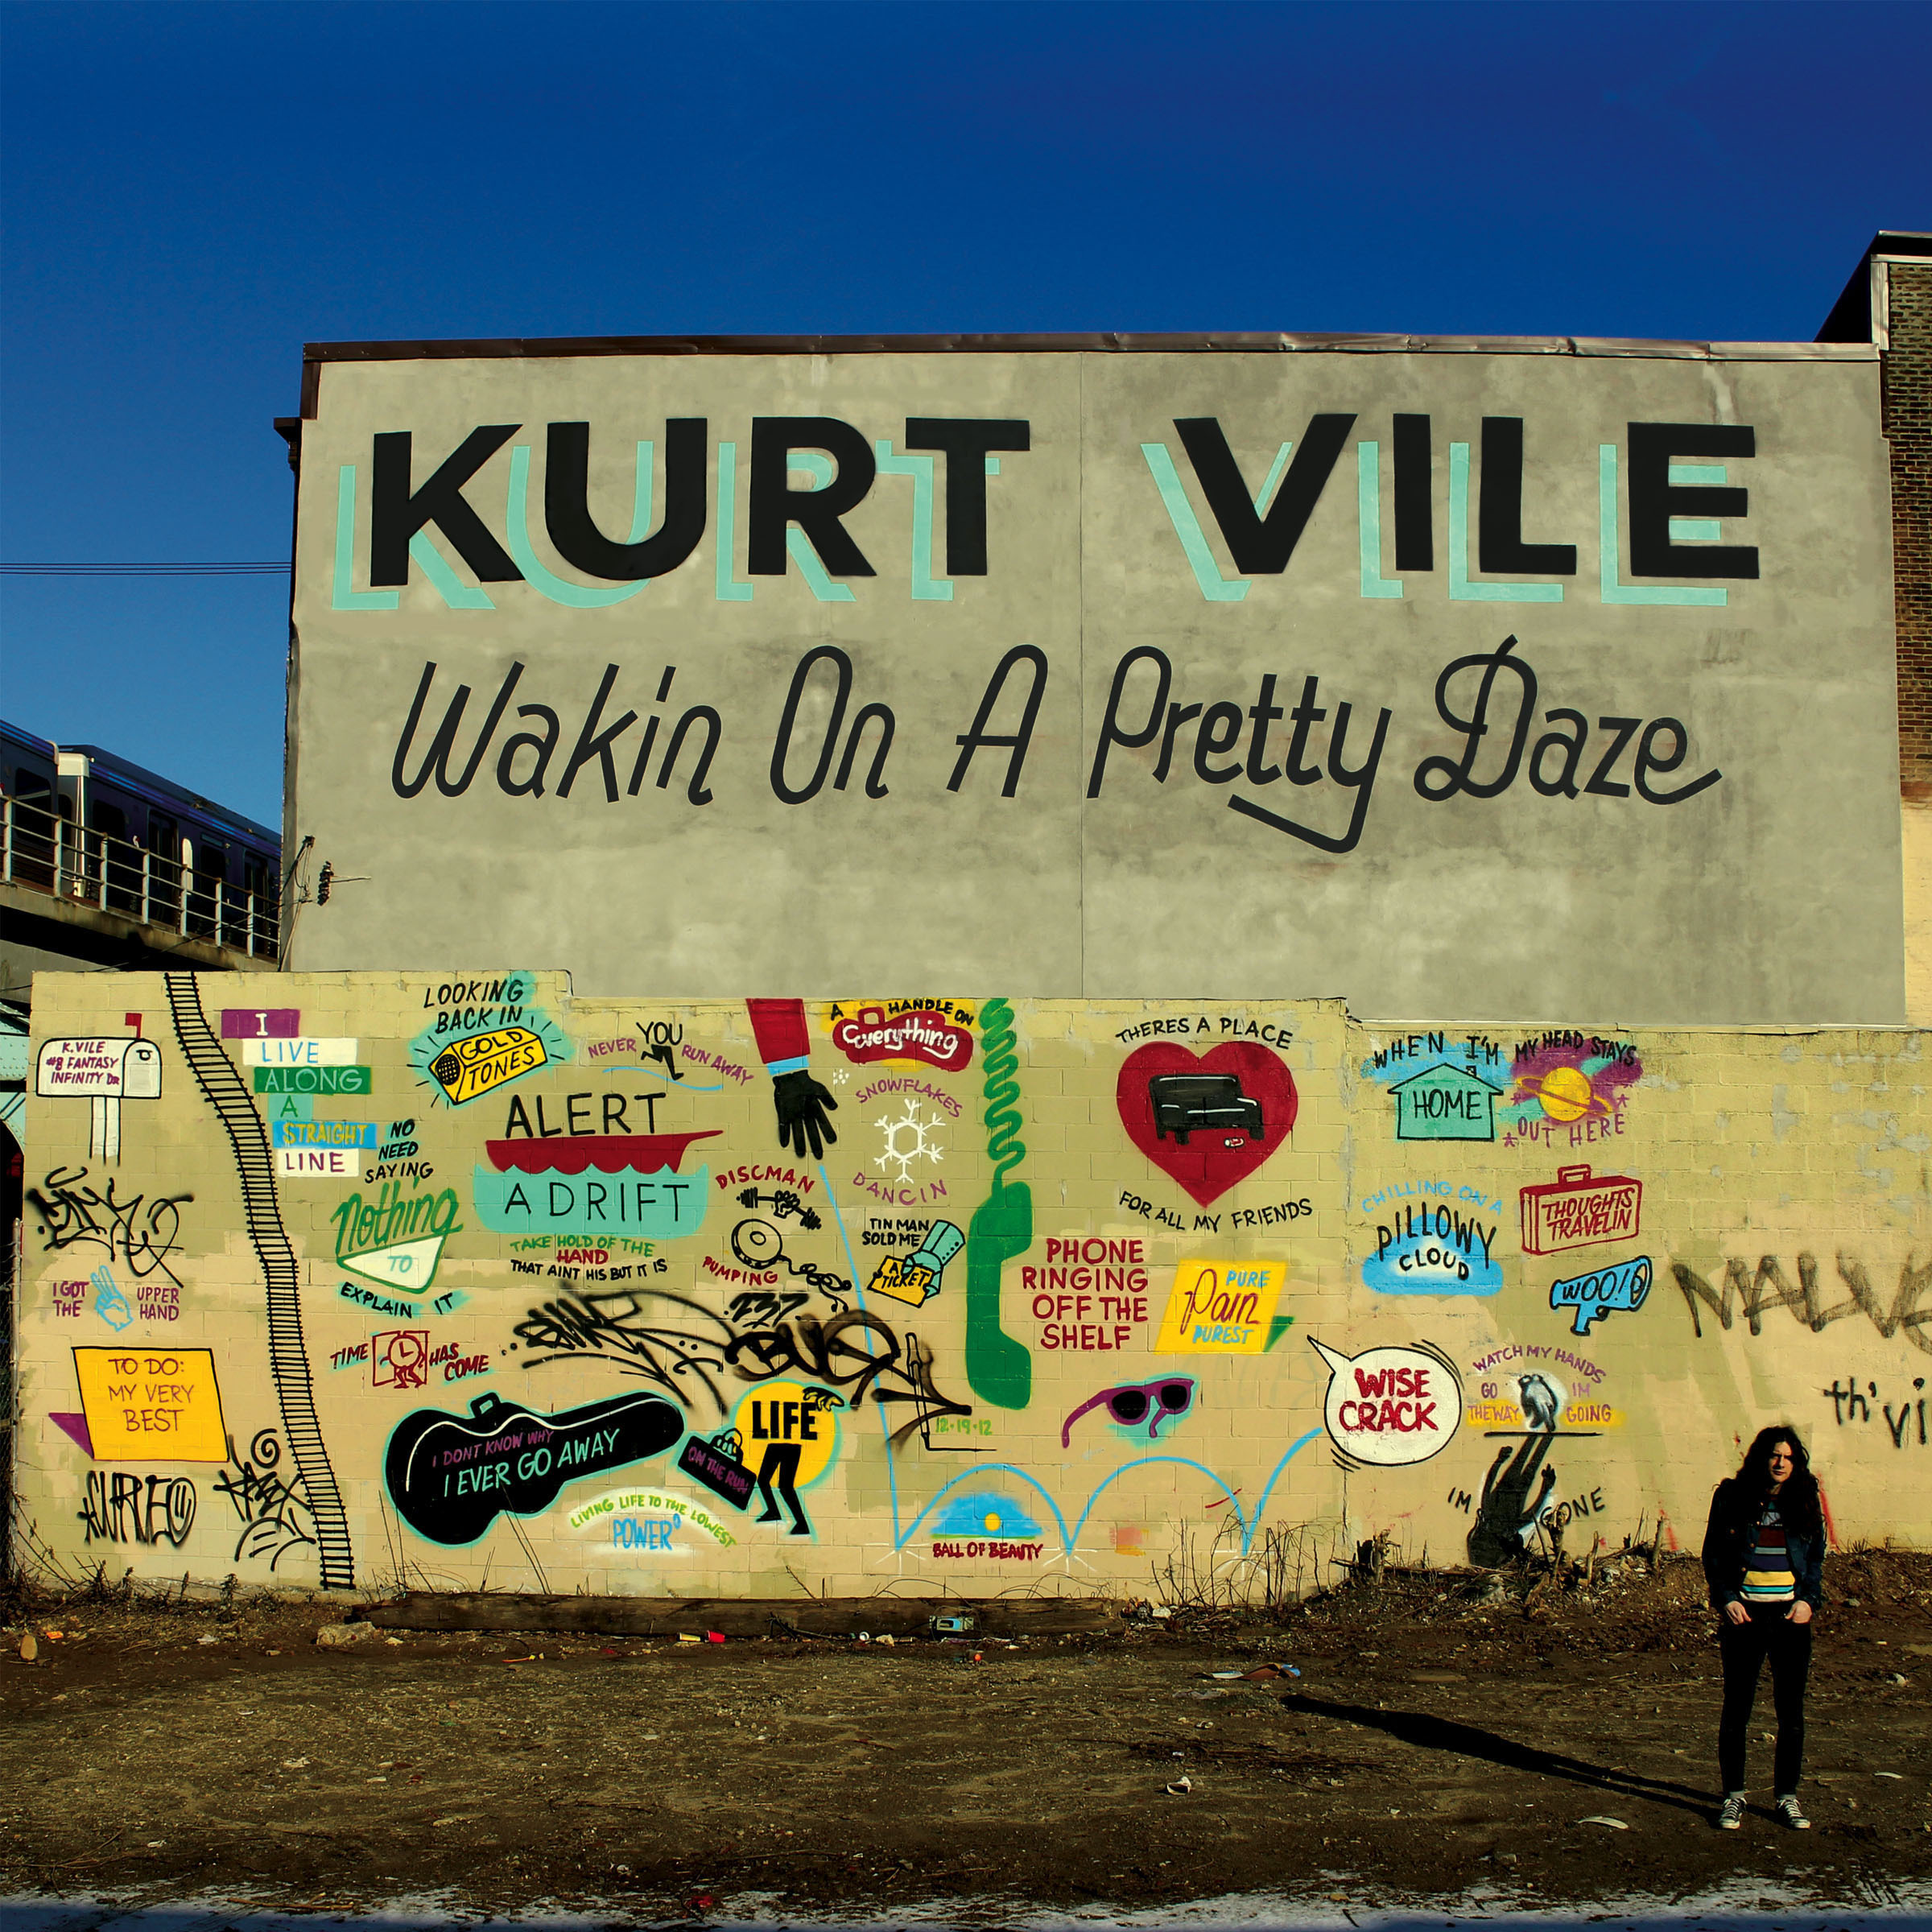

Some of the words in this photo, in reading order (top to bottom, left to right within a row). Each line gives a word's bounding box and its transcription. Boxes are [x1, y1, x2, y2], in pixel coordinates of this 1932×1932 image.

[370, 416, 1030, 587] KURT
[1173, 413, 1760, 579] VILE
[391, 659, 721, 806] Wakin
[770, 645, 895, 805] On
[946, 644, 1049, 799] A
[1086, 645, 1392, 854] Pretty
[1414, 634, 1723, 805] Daze
[423, 980, 524, 1008] LOOKING
[256, 1013, 269, 1036] I
[435, 1009, 489, 1034] BACK
[498, 1007, 522, 1024] IN
[831, 1004, 844, 1021] A
[889, 999, 953, 1014] HANDLE
[955, 1009, 974, 1026] ON
[460, 1027, 522, 1060] GOLD
[843, 1018, 959, 1059] Everything
[1115, 1018, 1190, 1043] THERES
[1196, 1017, 1210, 1033] A
[1220, 1018, 1293, 1050] PLACE
[262, 1042, 319, 1063] LIVE
[588, 1038, 637, 1059] NEVER
[636, 1022, 683, 1045] YOU
[681, 1044, 711, 1065] RUN
[711, 1058, 753, 1086] AWAY
[1374, 1030, 1444, 1069] WHEN
[1515, 1038, 1539, 1063] MY
[1542, 1030, 1584, 1051] HEAD
[1591, 1037, 1637, 1066] STAYS
[67, 1057, 118, 1069] FANTASY
[469, 1046, 535, 1091] TONES
[51, 1071, 104, 1084] INFINITY
[264, 1069, 362, 1092] ALONG
[280, 1095, 298, 1117] A
[856, 1079, 963, 1118] SNOWFLAKES
[1412, 1089, 1482, 1120] HOME
[506, 1092, 667, 1138] ALERT
[283, 1123, 368, 1145] STRAIGHT
[390, 1119, 415, 1138] NO
[1518, 1117, 1555, 1148] OUT
[1570, 1113, 1625, 1147] HERE
[286, 1152, 345, 1172] LINE
[378, 1141, 419, 1161] NEED
[365, 1162, 434, 1183] SAYING
[716, 1165, 815, 1193] DISCMAN
[852, 1172, 947, 1206] DANCIN
[1361, 1180, 1452, 1213] CHILLING
[1459, 1186, 1488, 1206] ON
[1488, 1200, 1503, 1215] A
[1120, 1191, 1152, 1219] FOR
[1155, 1208, 1186, 1230] ALL
[1194, 1214, 1221, 1232] MY
[1231, 1198, 1312, 1229] FRIENDS
[1542, 1188, 1636, 1221] THOUGHTS
[870, 1218, 892, 1229] TIN
[897, 1220, 929, 1232] MAN
[1377, 1201, 1496, 1269] PILLOWY
[1547, 1209, 1632, 1241] TRAVELIN
[510, 1236, 552, 1252] TAKE
[557, 1235, 593, 1247] HOLD
[597, 1237, 616, 1249] OF
[621, 1239, 655, 1257] THE
[862, 1231, 897, 1245] SOLD
[899, 1233, 921, 1247] ME
[1046, 1238, 1144, 1264] PHONE
[387, 1256, 413, 1272] TO
[510, 1259, 543, 1275] THAT
[547, 1265, 580, 1280] AINT
[586, 1269, 607, 1281] HIS
[610, 1265, 632, 1281] BUT
[638, 1265, 646, 1277] IT
[653, 1258, 667, 1274] IS
[556, 1249, 609, 1265] HAND
[889, 1262, 898, 1275] A
[1399, 1249, 1469, 1281] CLOUD
[702, 1256, 778, 1286] PUMPING
[882, 1270, 930, 1289] TICKET
[1022, 1267, 1148, 1293] RINGING
[1225, 1270, 1271, 1288] PURE
[52, 1282, 57, 1297] I
[60, 1282, 90, 1297] GOT
[137, 1287, 180, 1304] UPPER
[341, 1282, 412, 1319] EXPLAIN
[435, 1293, 453, 1315] IT
[52, 1300, 84, 1317] THE
[139, 1304, 180, 1321] HAND
[1032, 1294, 1092, 1321] OFF
[1099, 1296, 1148, 1322] THE
[1041, 1323, 1131, 1350] SHELF
[1192, 1326, 1254, 1344] PUREST
[108, 1358, 138, 1375] TO
[145, 1358, 184, 1375] DO:
[330, 1343, 369, 1369] TIME
[429, 1342, 459, 1366] HAS
[1472, 1345, 1523, 1372] WATCH
[1526, 1345, 1552, 1358] MY
[1554, 1348, 1607, 1384] HANDS
[444, 1355, 489, 1381] COME
[108, 1385, 138, 1402] MY
[145, 1385, 194, 1404] VERY
[1355, 1368, 1431, 1399] WISE
[1481, 1382, 1498, 1398] GO
[1571, 1382, 1591, 1397] IM
[122, 1409, 184, 1431] BEST
[752, 1401, 818, 1440] LIFE
[1339, 1401, 1439, 1432] CRACK
[1468, 1406, 1490, 1421] THE
[1492, 1406, 1519, 1422] WAY
[1566, 1404, 1612, 1423] GOING
[432, 1455, 436, 1468] I
[444, 1443, 482, 1466] DONT
[485, 1432, 523, 1455] KNOW
[527, 1429, 554, 1445] WHY
[444, 1474, 449, 1497] I
[457, 1462, 511, 1496] EVER
[518, 1448, 551, 1480] GO
[557, 1428, 620, 1468] AWAY
[688, 1447, 706, 1466] ON
[707, 1457, 726, 1480] THE
[724, 1470, 749, 1494] RUN
[1447, 1488, 1472, 1514] IM
[571, 1498, 614, 1529] LIVING
[619, 1495, 645, 1509] LIFE
[648, 1496, 662, 1508] TO
[666, 1498, 687, 1514] THE
[690, 1510, 737, 1548] LOWEST
[933, 1542, 964, 1558] BALL
[967, 1542, 985, 1558] OF
[988, 1542, 1043, 1561] BEAUTY
